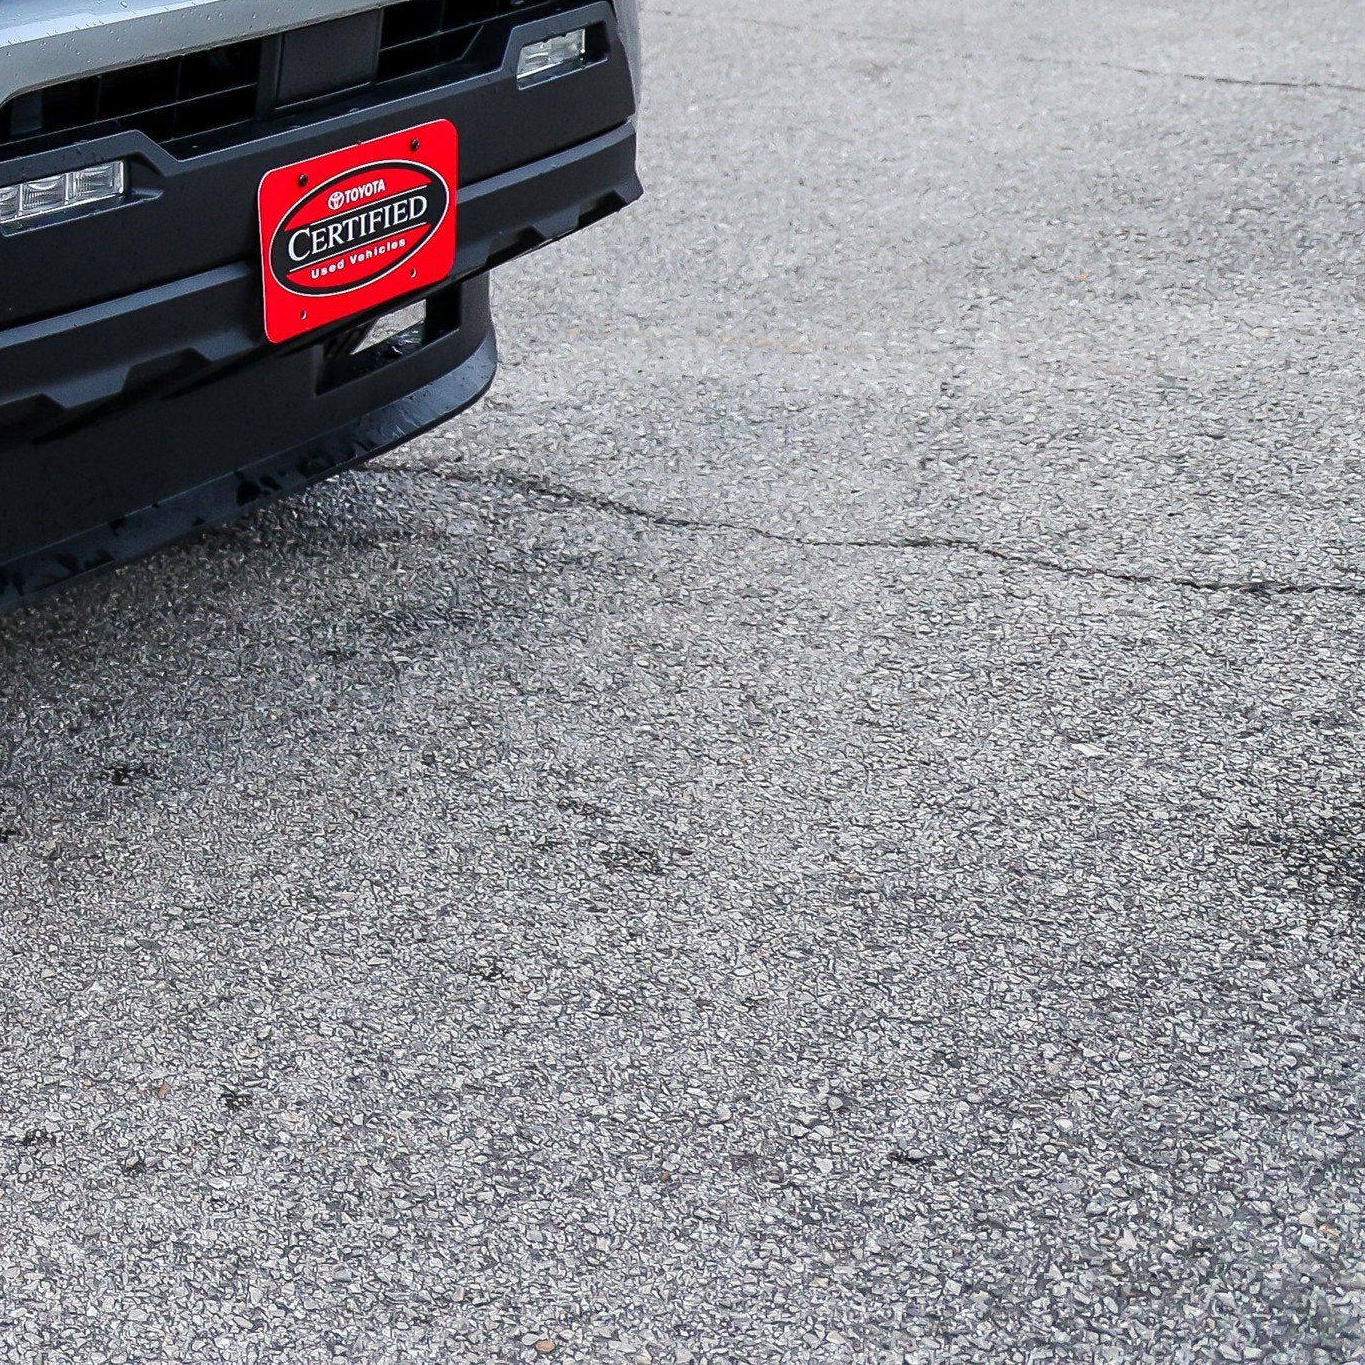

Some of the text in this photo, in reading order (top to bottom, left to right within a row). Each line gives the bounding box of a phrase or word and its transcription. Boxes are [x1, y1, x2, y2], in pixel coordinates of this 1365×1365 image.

[344, 178, 387, 204] TOYOTA
[287, 195, 428, 262] CERTIFIED
[310, 238, 406, 279] Used Vehicles
